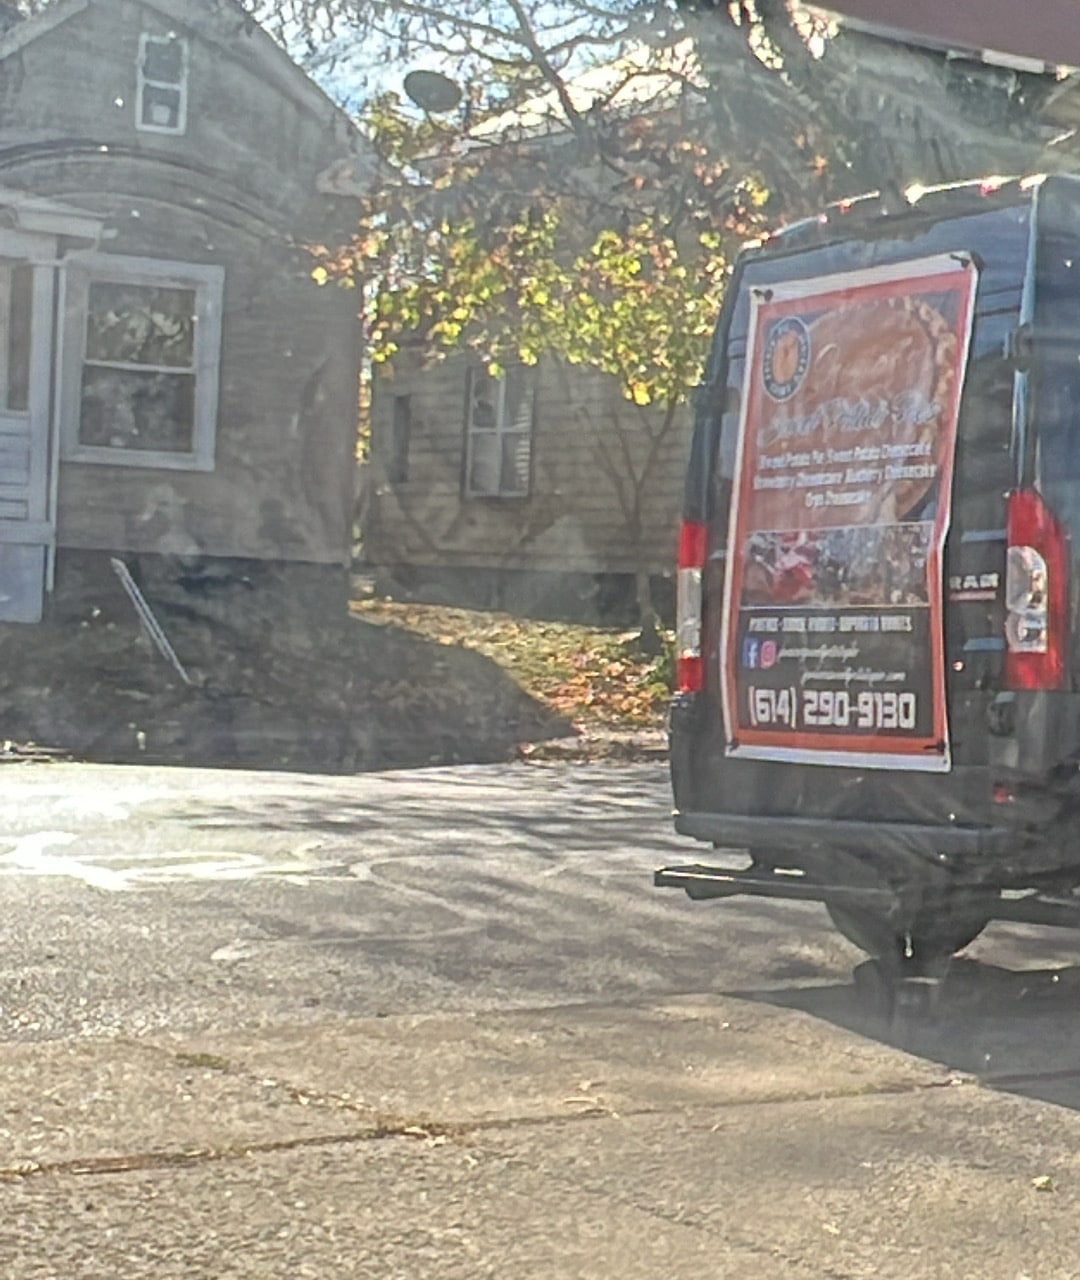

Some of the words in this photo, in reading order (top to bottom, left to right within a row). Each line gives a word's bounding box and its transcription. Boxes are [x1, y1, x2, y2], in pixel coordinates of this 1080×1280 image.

[948, 572, 999, 590] RAM
[749, 685, 796, 729] (614)
[803, 690, 916, 729] 290-9130
